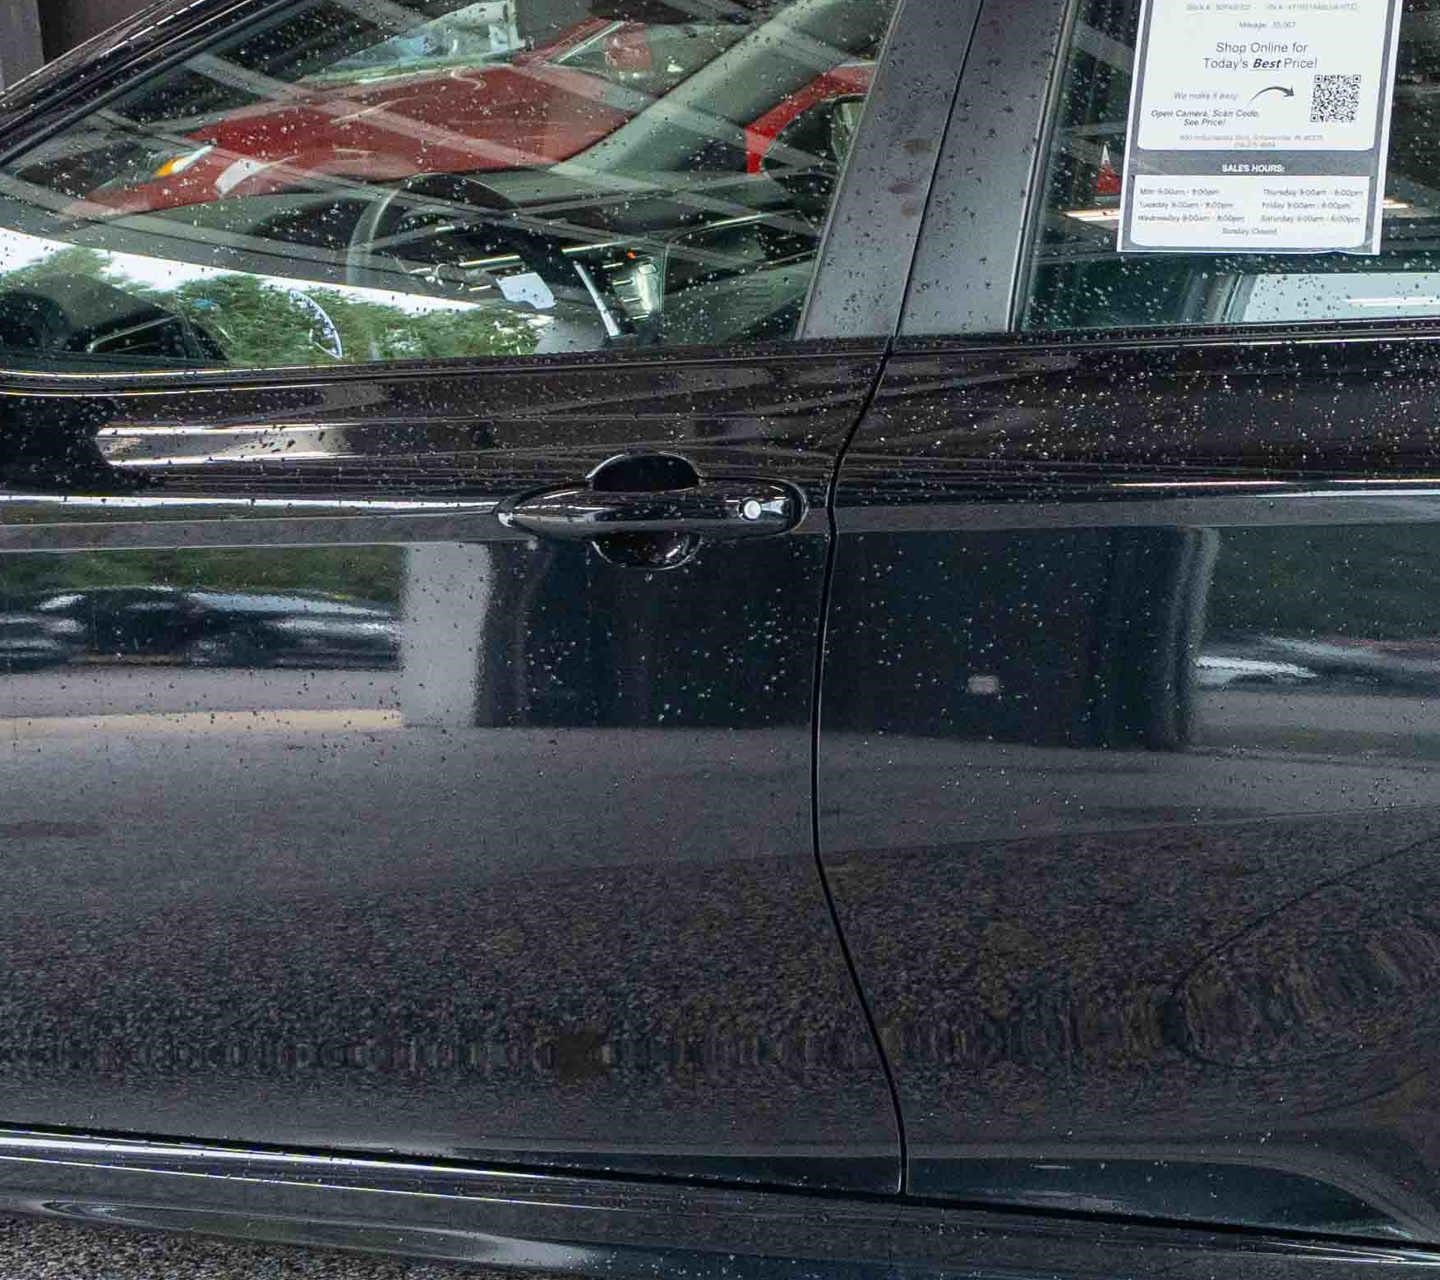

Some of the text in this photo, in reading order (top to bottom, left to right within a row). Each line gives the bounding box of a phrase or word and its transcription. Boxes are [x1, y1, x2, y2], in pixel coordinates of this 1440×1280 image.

[1216, 41, 1308, 55] Shop Online for
[1202, 57, 1317, 71] Today's Best Price!
[1151, 109, 1173, 119] Open
[1212, 108, 1233, 118] Scan
[1184, 118, 1226, 127] See Price!
[1222, 164, 1285, 173] SALES HOURS:
